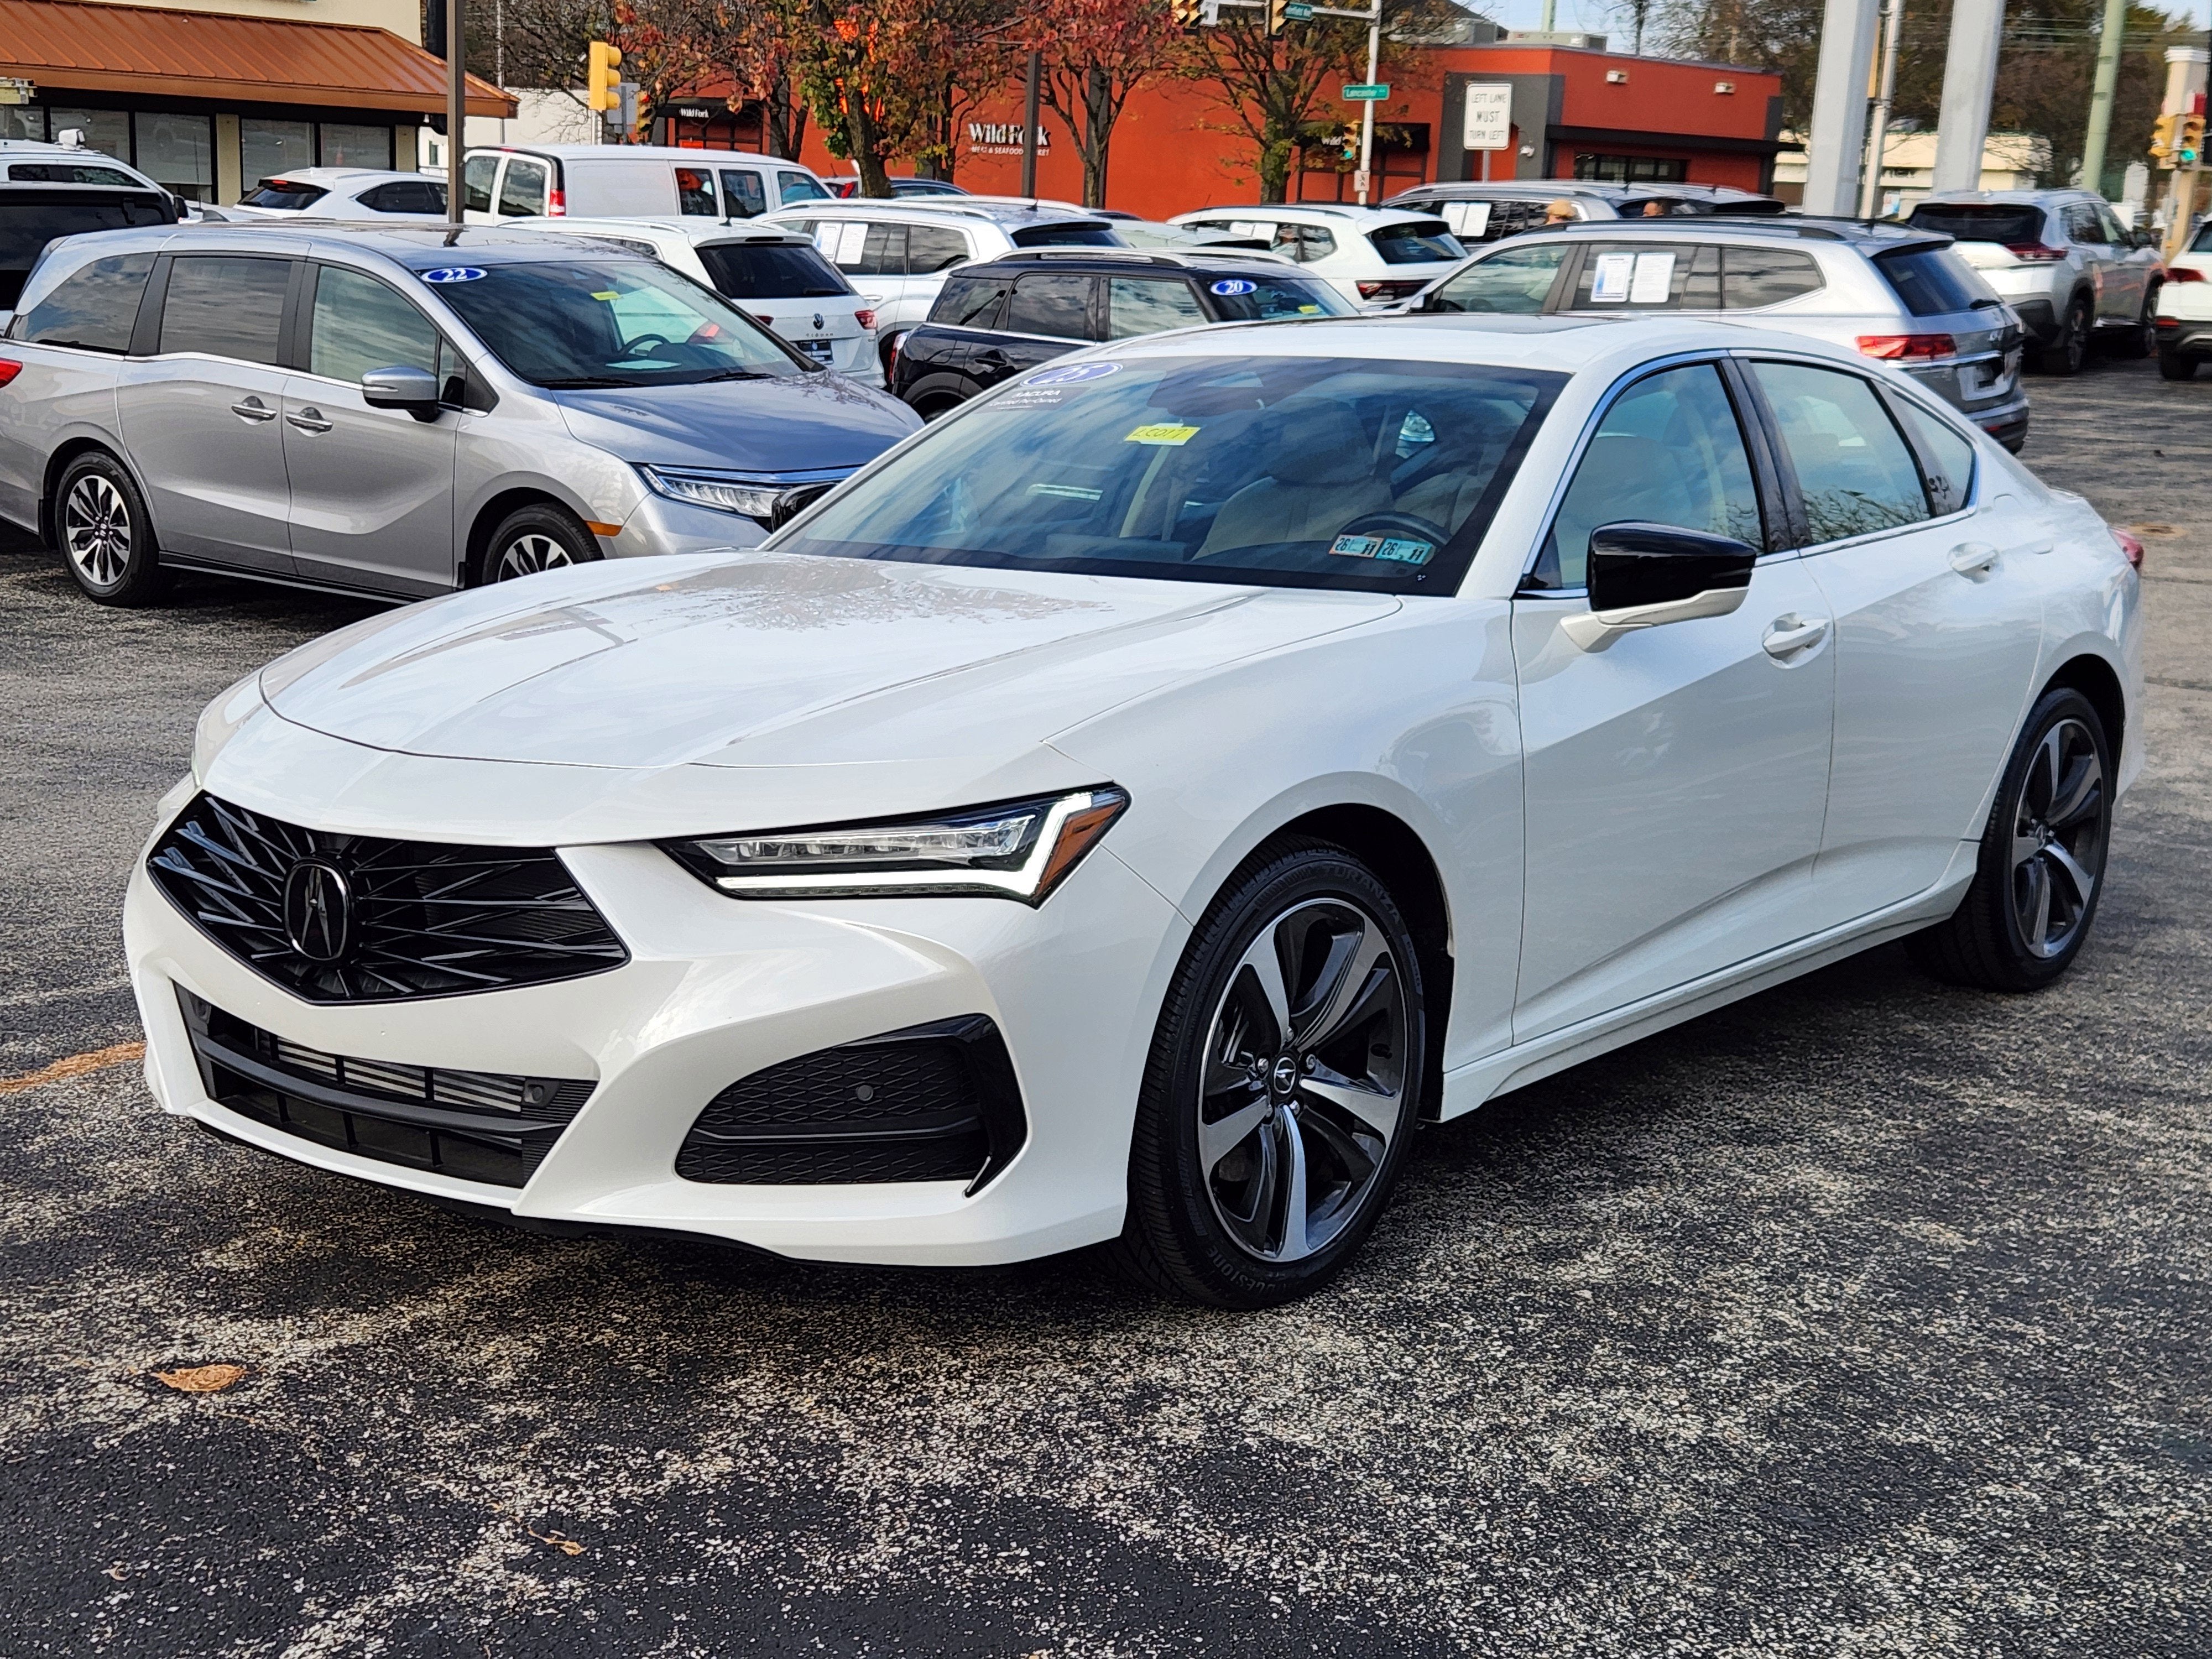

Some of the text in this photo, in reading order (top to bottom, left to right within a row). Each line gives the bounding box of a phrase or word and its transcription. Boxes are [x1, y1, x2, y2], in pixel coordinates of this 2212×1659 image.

[1472, 93, 1507, 103] LEFT LANE
[1476, 111, 1500, 122] MUST
[969, 123, 1050, 146] Wild Fok
[1469, 130, 1505, 139] TURN LEFT
[441, 268, 467, 281] 22
[1225, 280, 1244, 293] 20
[1033, 365, 1105, 385] 25
[1334, 538, 1377, 555] 26 11
[1381, 542, 1425, 561] 26 11
